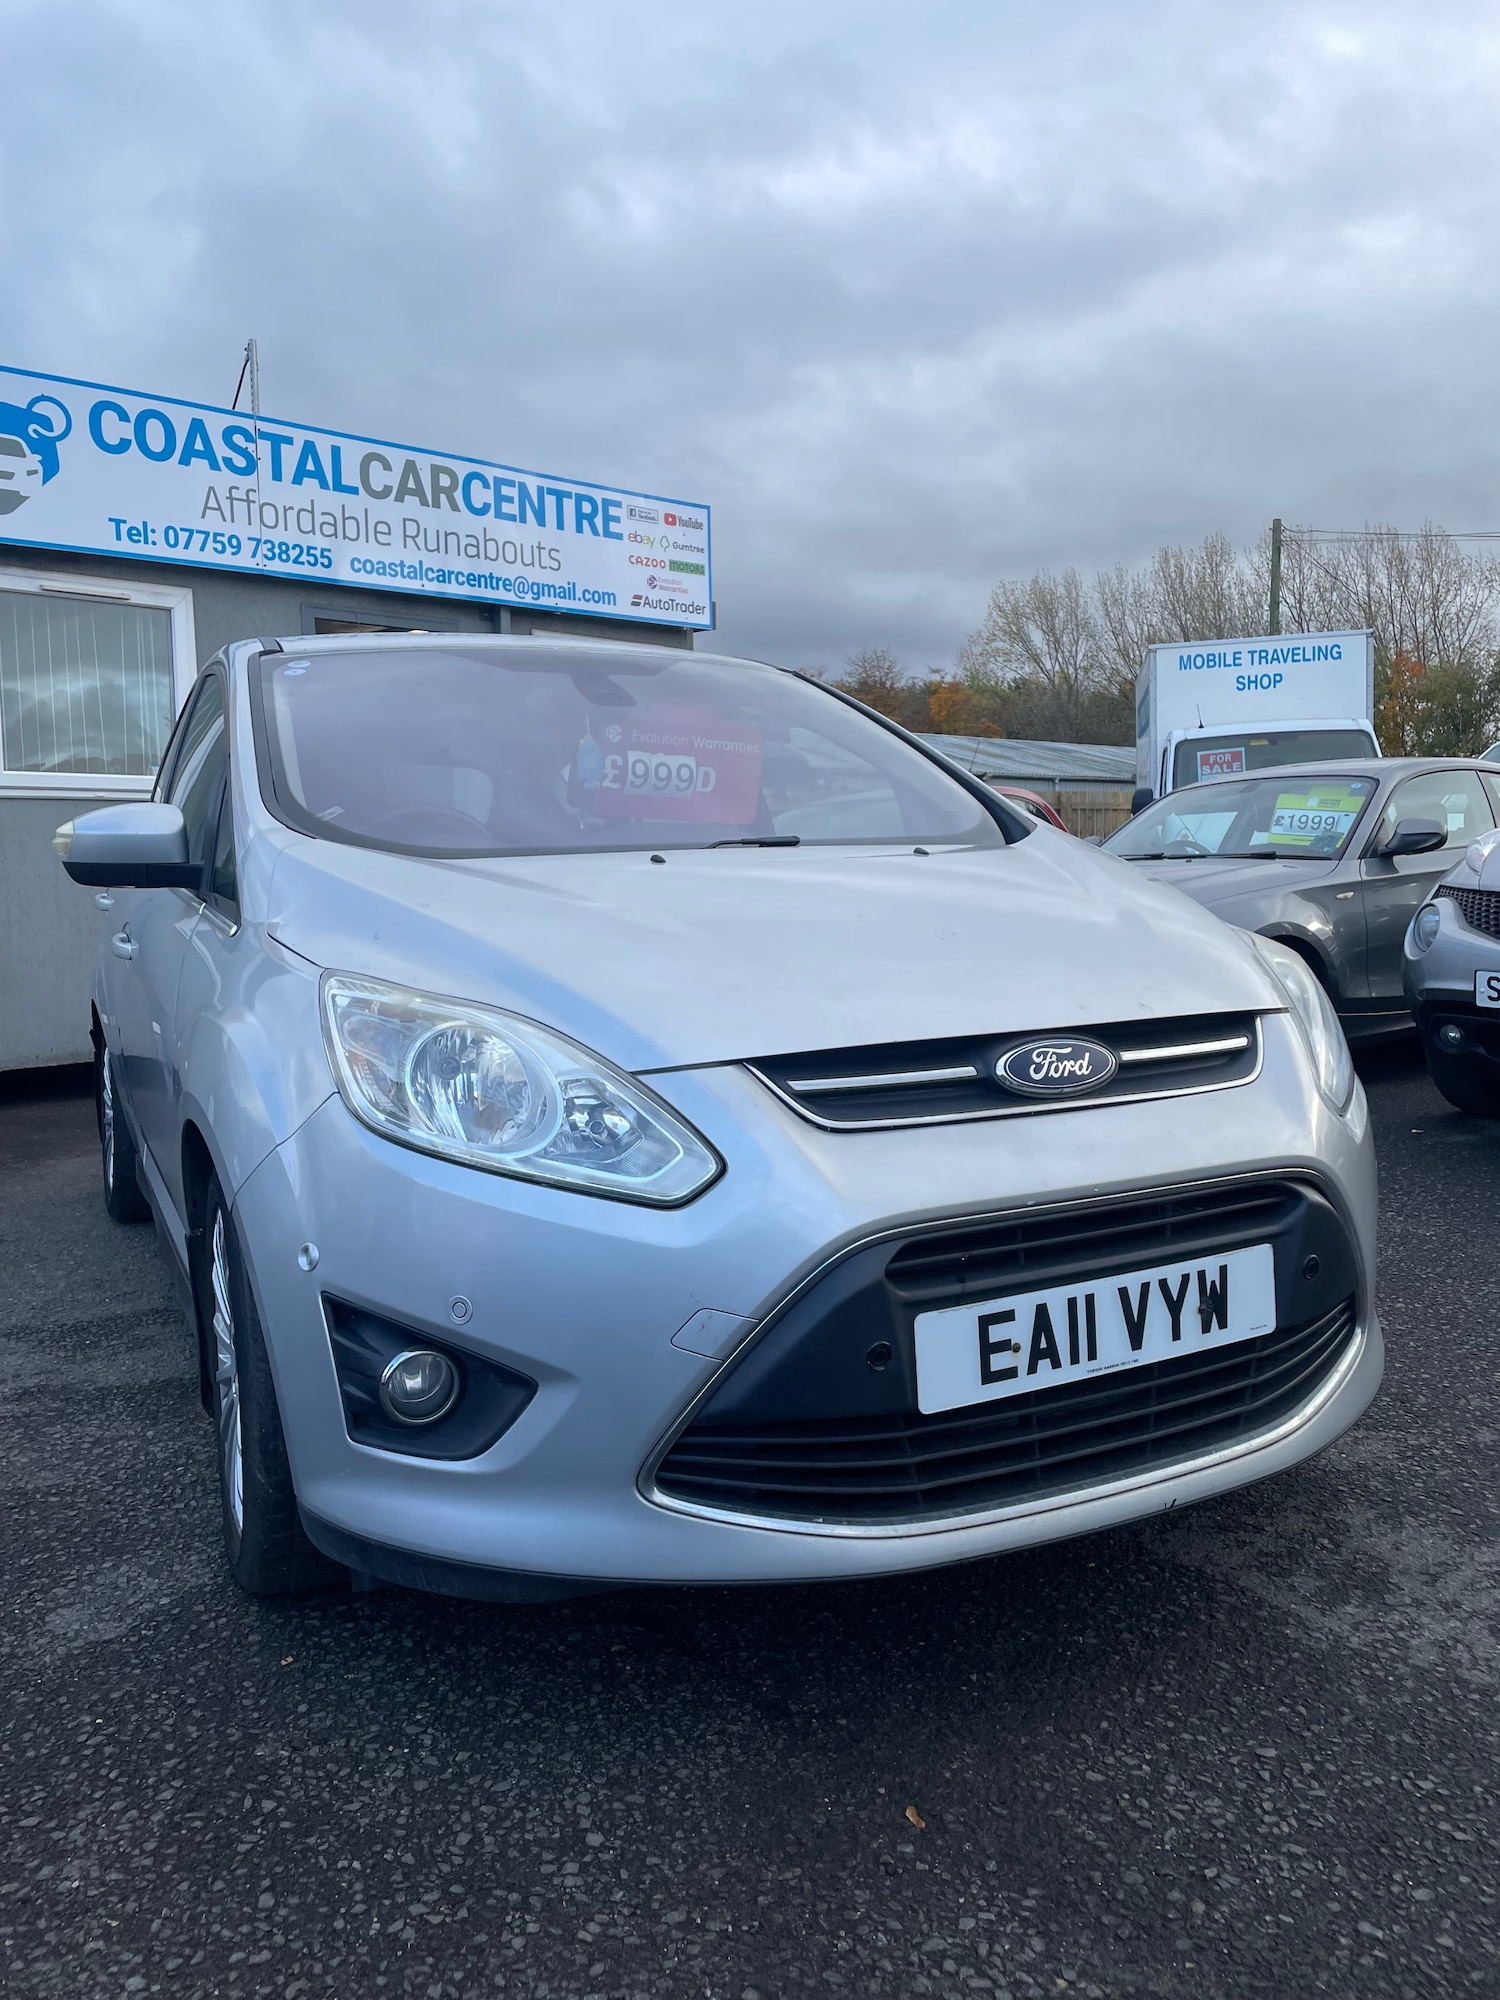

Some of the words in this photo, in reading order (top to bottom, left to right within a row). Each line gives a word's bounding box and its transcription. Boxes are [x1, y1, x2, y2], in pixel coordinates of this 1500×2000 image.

[200, 486, 392, 546] Affordable
[402, 517, 562, 571] Runabouts
[677, 515, 704, 531] YouTube
[108, 517, 157, 546] Tel:
[164, 525, 242, 556] 07759
[247, 536, 333, 569] 738255
[628, 530, 655, 549] ebay
[672, 541, 705, 554] Gumtree
[628, 554, 667, 569] CAZOO
[350, 556, 617, 606] coastalcarcentre@gmail.com
[642, 595, 706, 615] AutoTrader
[1179, 650, 1243, 671] MOBILE
[1247, 643, 1343, 666] TRAVELING
[1235, 673, 1284, 692] SHOP
[632, 729, 689, 746] Evolution
[693, 735, 761, 753] Warranties
[1209, 753, 1232, 764] FOR
[1201, 762, 1242, 775] SALE
[1273, 814, 1336, 832] £1999
[1029, 1047, 1093, 1081] Ford
[1118, 1264, 1229, 1352] VYW
